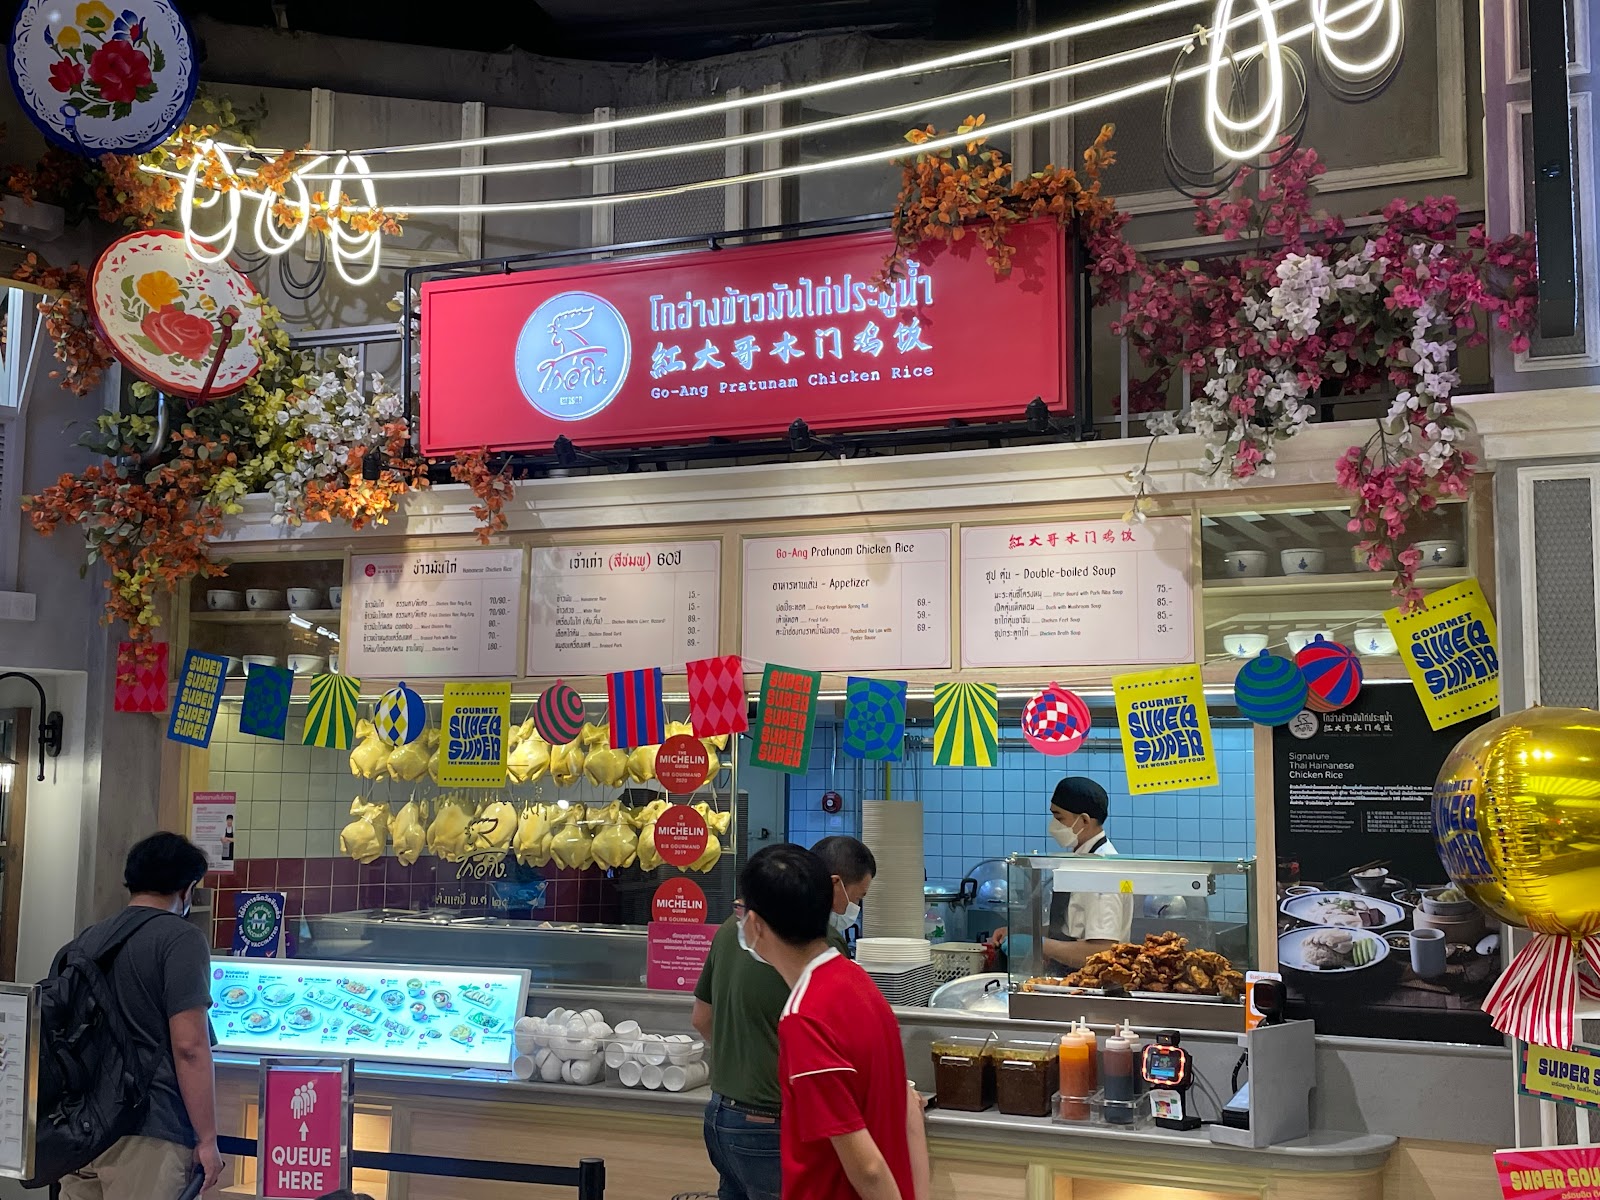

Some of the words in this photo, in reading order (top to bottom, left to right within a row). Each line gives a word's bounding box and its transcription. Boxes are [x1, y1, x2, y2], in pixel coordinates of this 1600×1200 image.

[651, 384, 708, 399] Go-Ang
[720, 377, 798, 394] Pratunam
[808, 369, 881, 387] Chicken
[892, 366, 933, 380] Rice
[776, 548, 808, 560] Go-Ang
[811, 546, 853, 557] Pratunam
[856, 543, 891, 555] Chicken
[895, 542, 915, 553] Rice
[413, 558, 457, 575] ข้าวมันไก่
[1023, 566, 1089, 579] Double-boiled
[1092, 566, 1116, 578] Soup
[688, 590, 701, 598] 15.-
[830, 577, 870, 590] Appetizer
[1157, 585, 1172, 593] 75.-
[688, 602, 701, 610] 15.-
[917, 598, 931, 606] 69.-
[1157, 598, 1172, 606] 85.-
[917, 611, 931, 619] 59.-
[1157, 611, 1172, 620] 85.-
[917, 623, 931, 632] 69.-
[1411, 612, 1472, 641] GOURMET
[1411, 620, 1491, 669] SUPER
[190, 655, 222, 678] SUPER
[1424, 645, 1499, 695] SUPER
[185, 671, 218, 693] SUPER
[769, 670, 812, 693] SUPER
[1433, 693, 1447, 701] THE
[1447, 683, 1477, 697] WONDER
[1487, 673, 1499, 683] FOO
[181, 687, 215, 709] SUPER
[766, 688, 809, 712] SUPER
[1131, 695, 1188, 710] GOURMET
[177, 703, 211, 725] SUPER
[455, 707, 499, 715] GOURMET
[764, 707, 807, 731] SUPER
[1128, 703, 1199, 739] SUPER
[173, 719, 207, 741] SUPER
[449, 715, 502, 740] SUPER
[761, 725, 804, 750] SUPER
[448, 736, 501, 760] SUPER
[758, 743, 802, 768] SUPER
[1133, 729, 1205, 763] SUPER
[1289, 752, 1330, 762] Signature
[659, 755, 705, 765] MICHELIN
[1150, 760, 1177, 768] WONDER
[1289, 761, 1308, 770] Thai
[1309, 761, 1355, 770] Hainanese
[1289, 771, 1324, 780] Chicken
[1325, 771, 1344, 780] Rice
[658, 826, 704, 836] MICHELIN
[656, 899, 703, 909] MICHELIN
[1538, 1057, 1590, 1085] SUPER
[271, 1145, 332, 1167] QUEUE
[278, 1170, 324, 1192] HERE
[1510, 1169, 1566, 1191] SUPER
